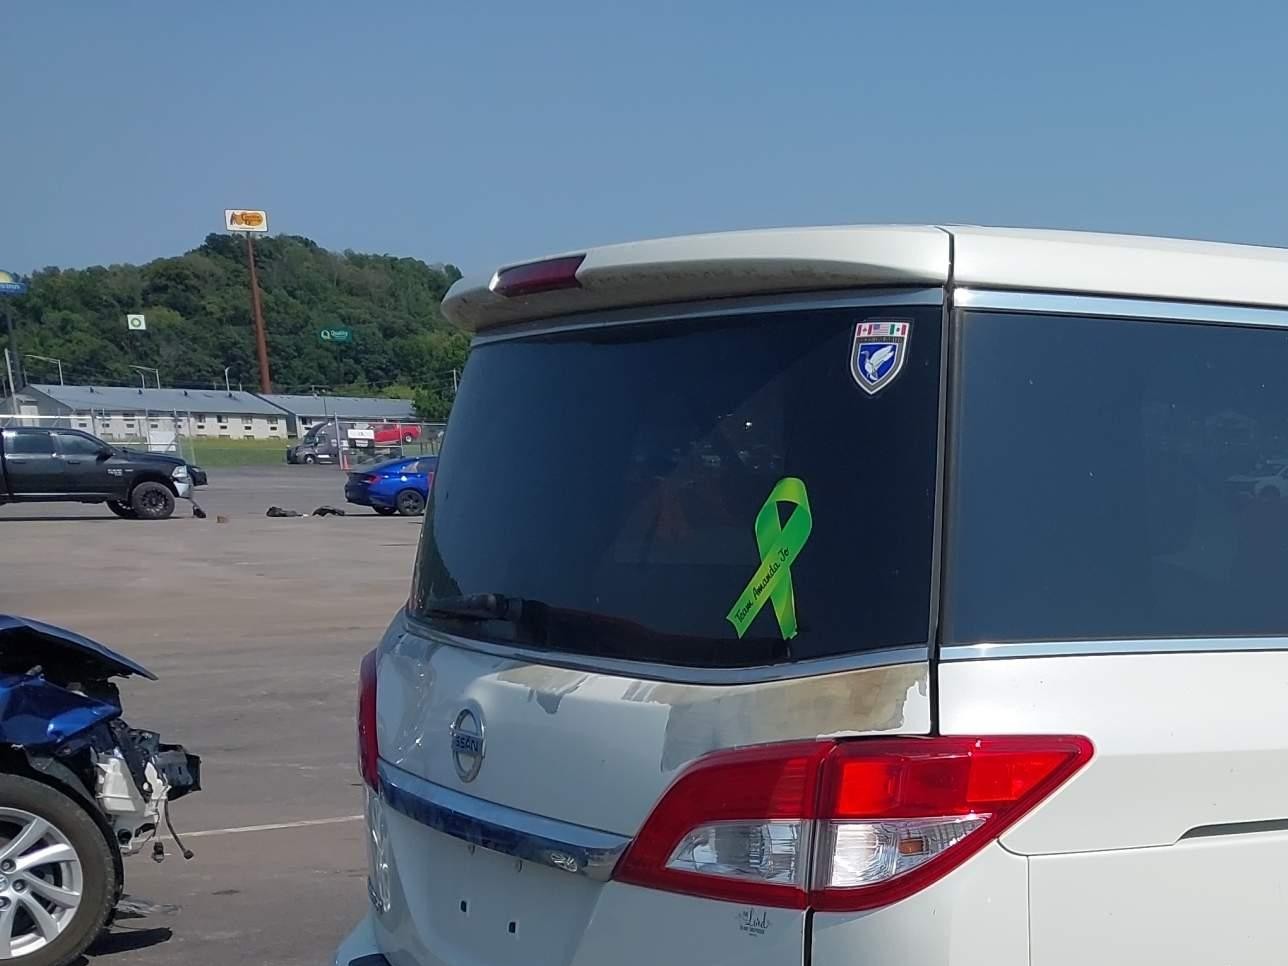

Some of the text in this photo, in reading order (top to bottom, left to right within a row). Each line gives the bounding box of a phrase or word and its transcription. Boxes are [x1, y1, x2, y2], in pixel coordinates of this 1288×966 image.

[734, 546, 790, 623] Team Amanda Jo
